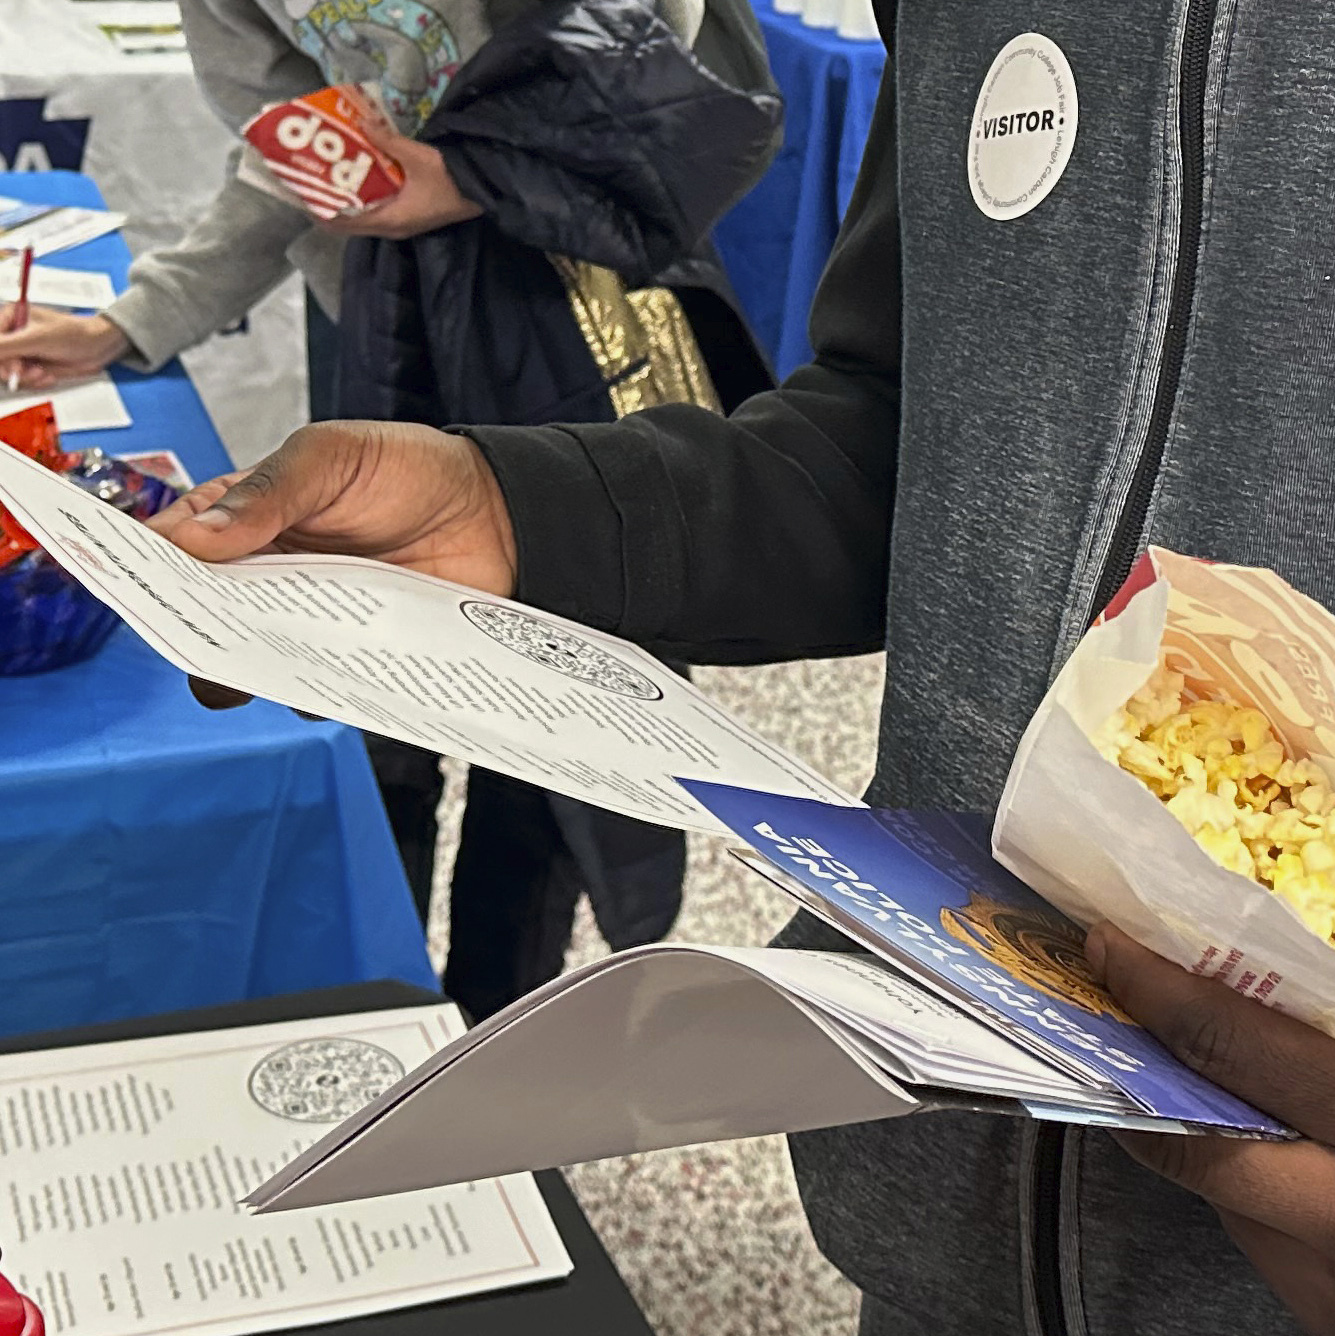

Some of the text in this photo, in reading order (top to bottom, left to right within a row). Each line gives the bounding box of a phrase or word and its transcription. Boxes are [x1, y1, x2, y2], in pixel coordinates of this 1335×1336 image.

[983, 109, 1054, 139] VISITOR
[752, 820, 1139, 1073] PENNSYLVANIA
[790, 835, 970, 957] POLICE
[970, 965, 1145, 1067] STATE
